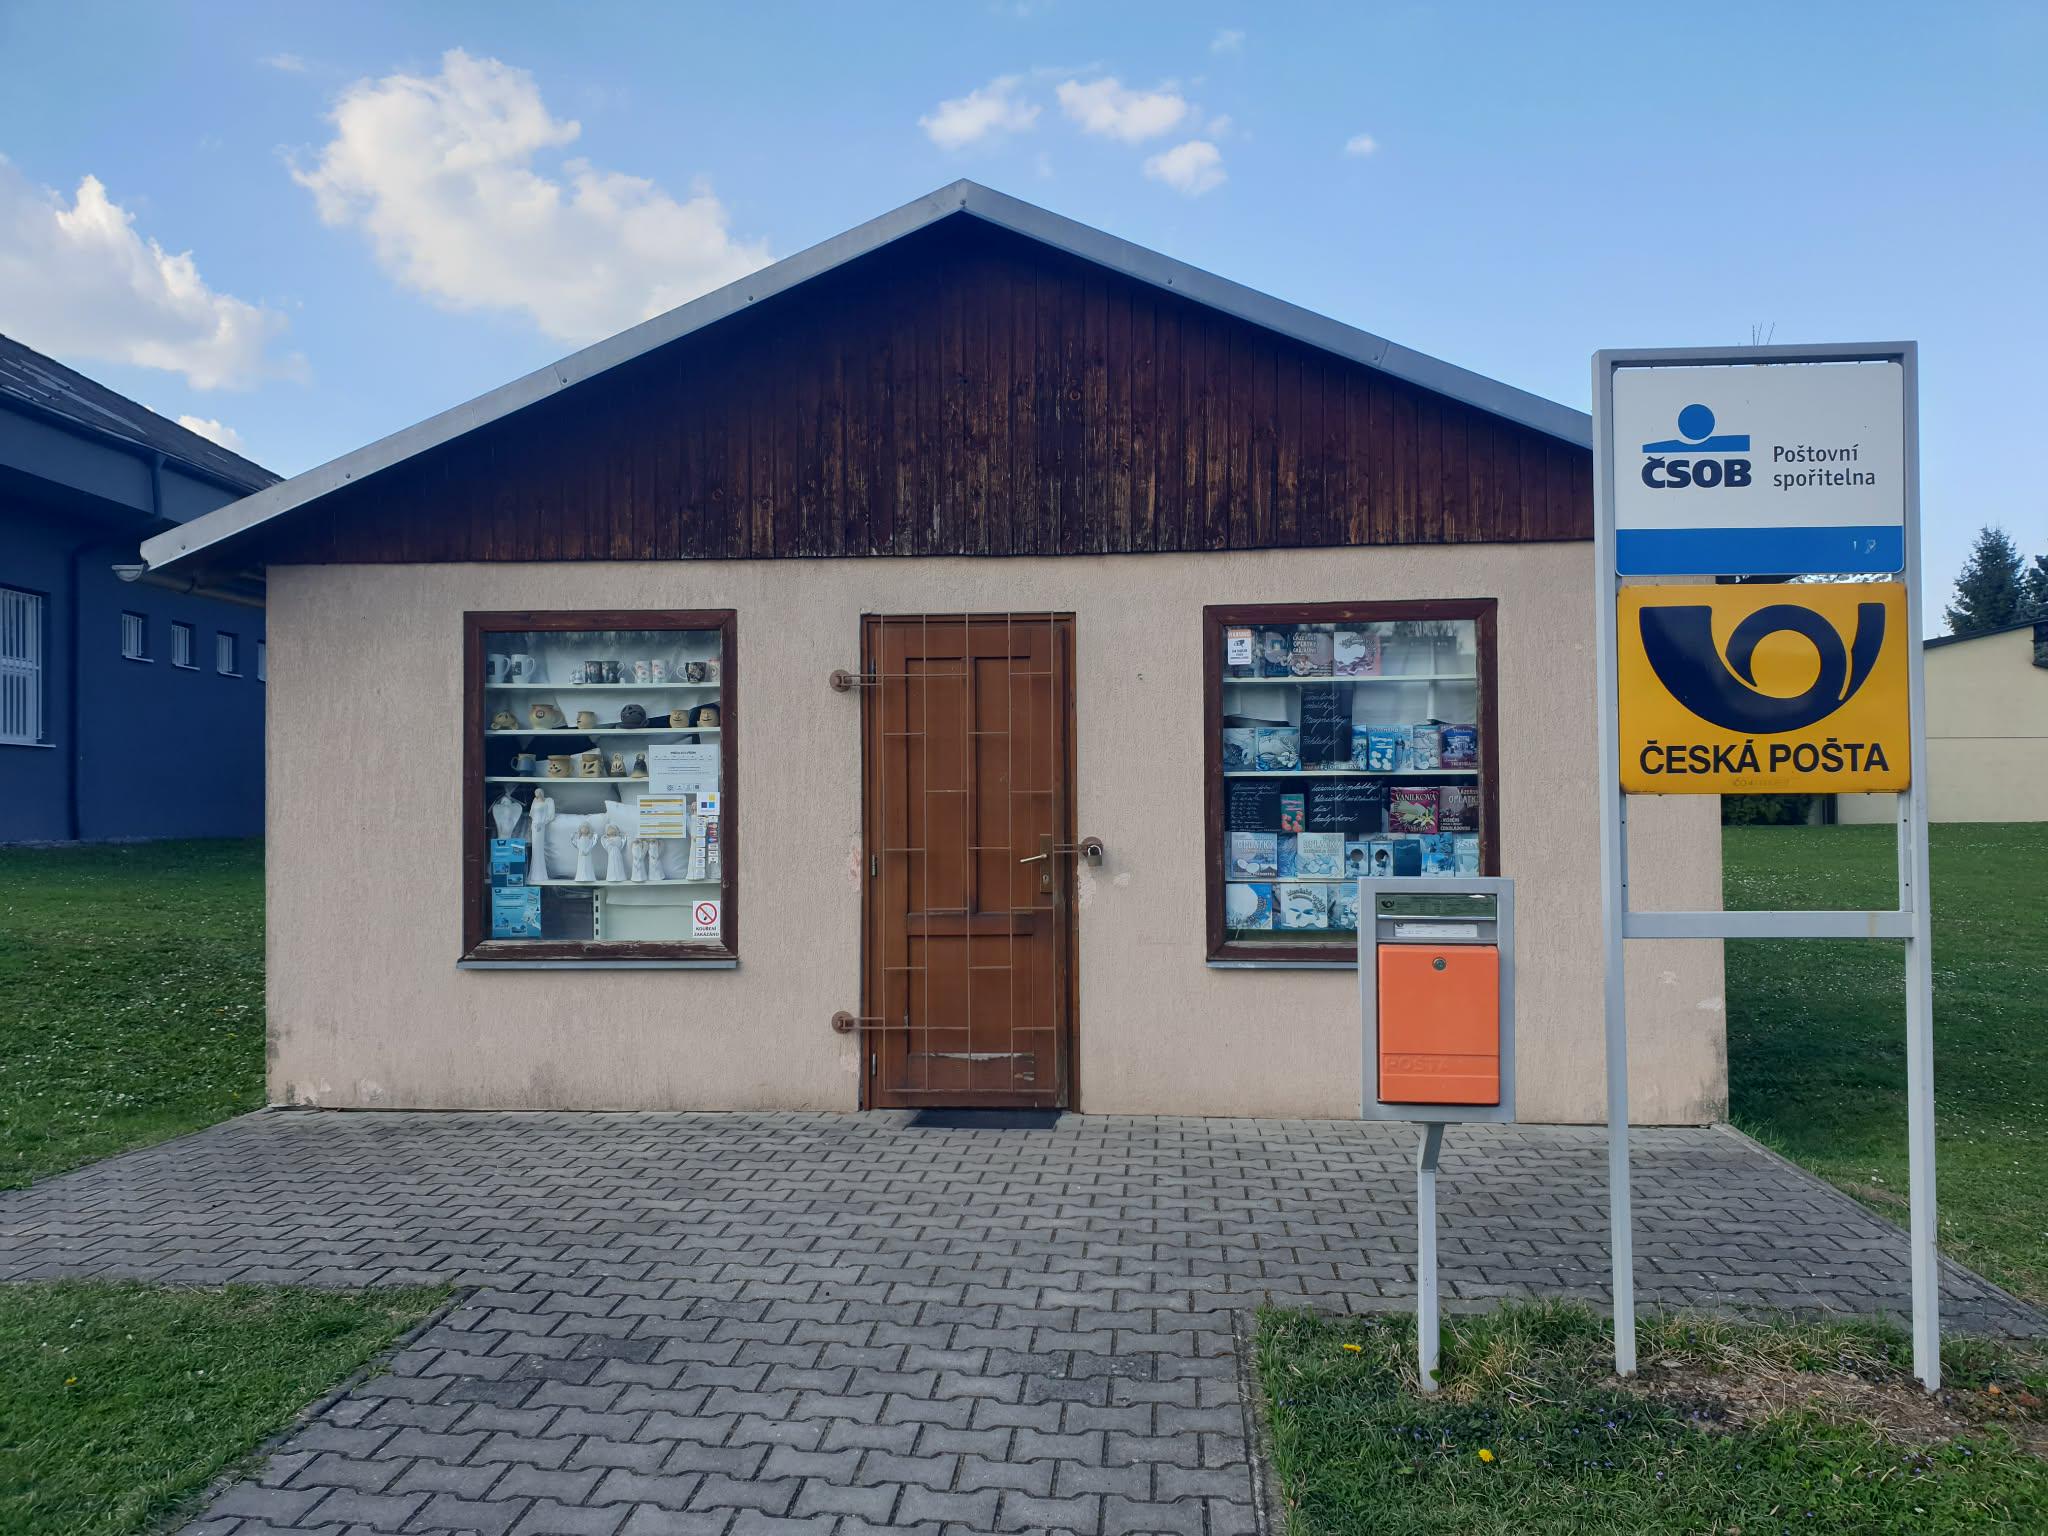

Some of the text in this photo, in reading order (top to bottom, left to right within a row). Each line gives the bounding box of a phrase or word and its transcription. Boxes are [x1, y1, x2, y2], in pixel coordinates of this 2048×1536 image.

[1773, 443, 1858, 463] Poštovní
[1641, 455, 1752, 489] ČSOB
[1773, 466, 1876, 491] spořitelna
[1640, 737, 1890, 775] ČESKÁ POŠTA
